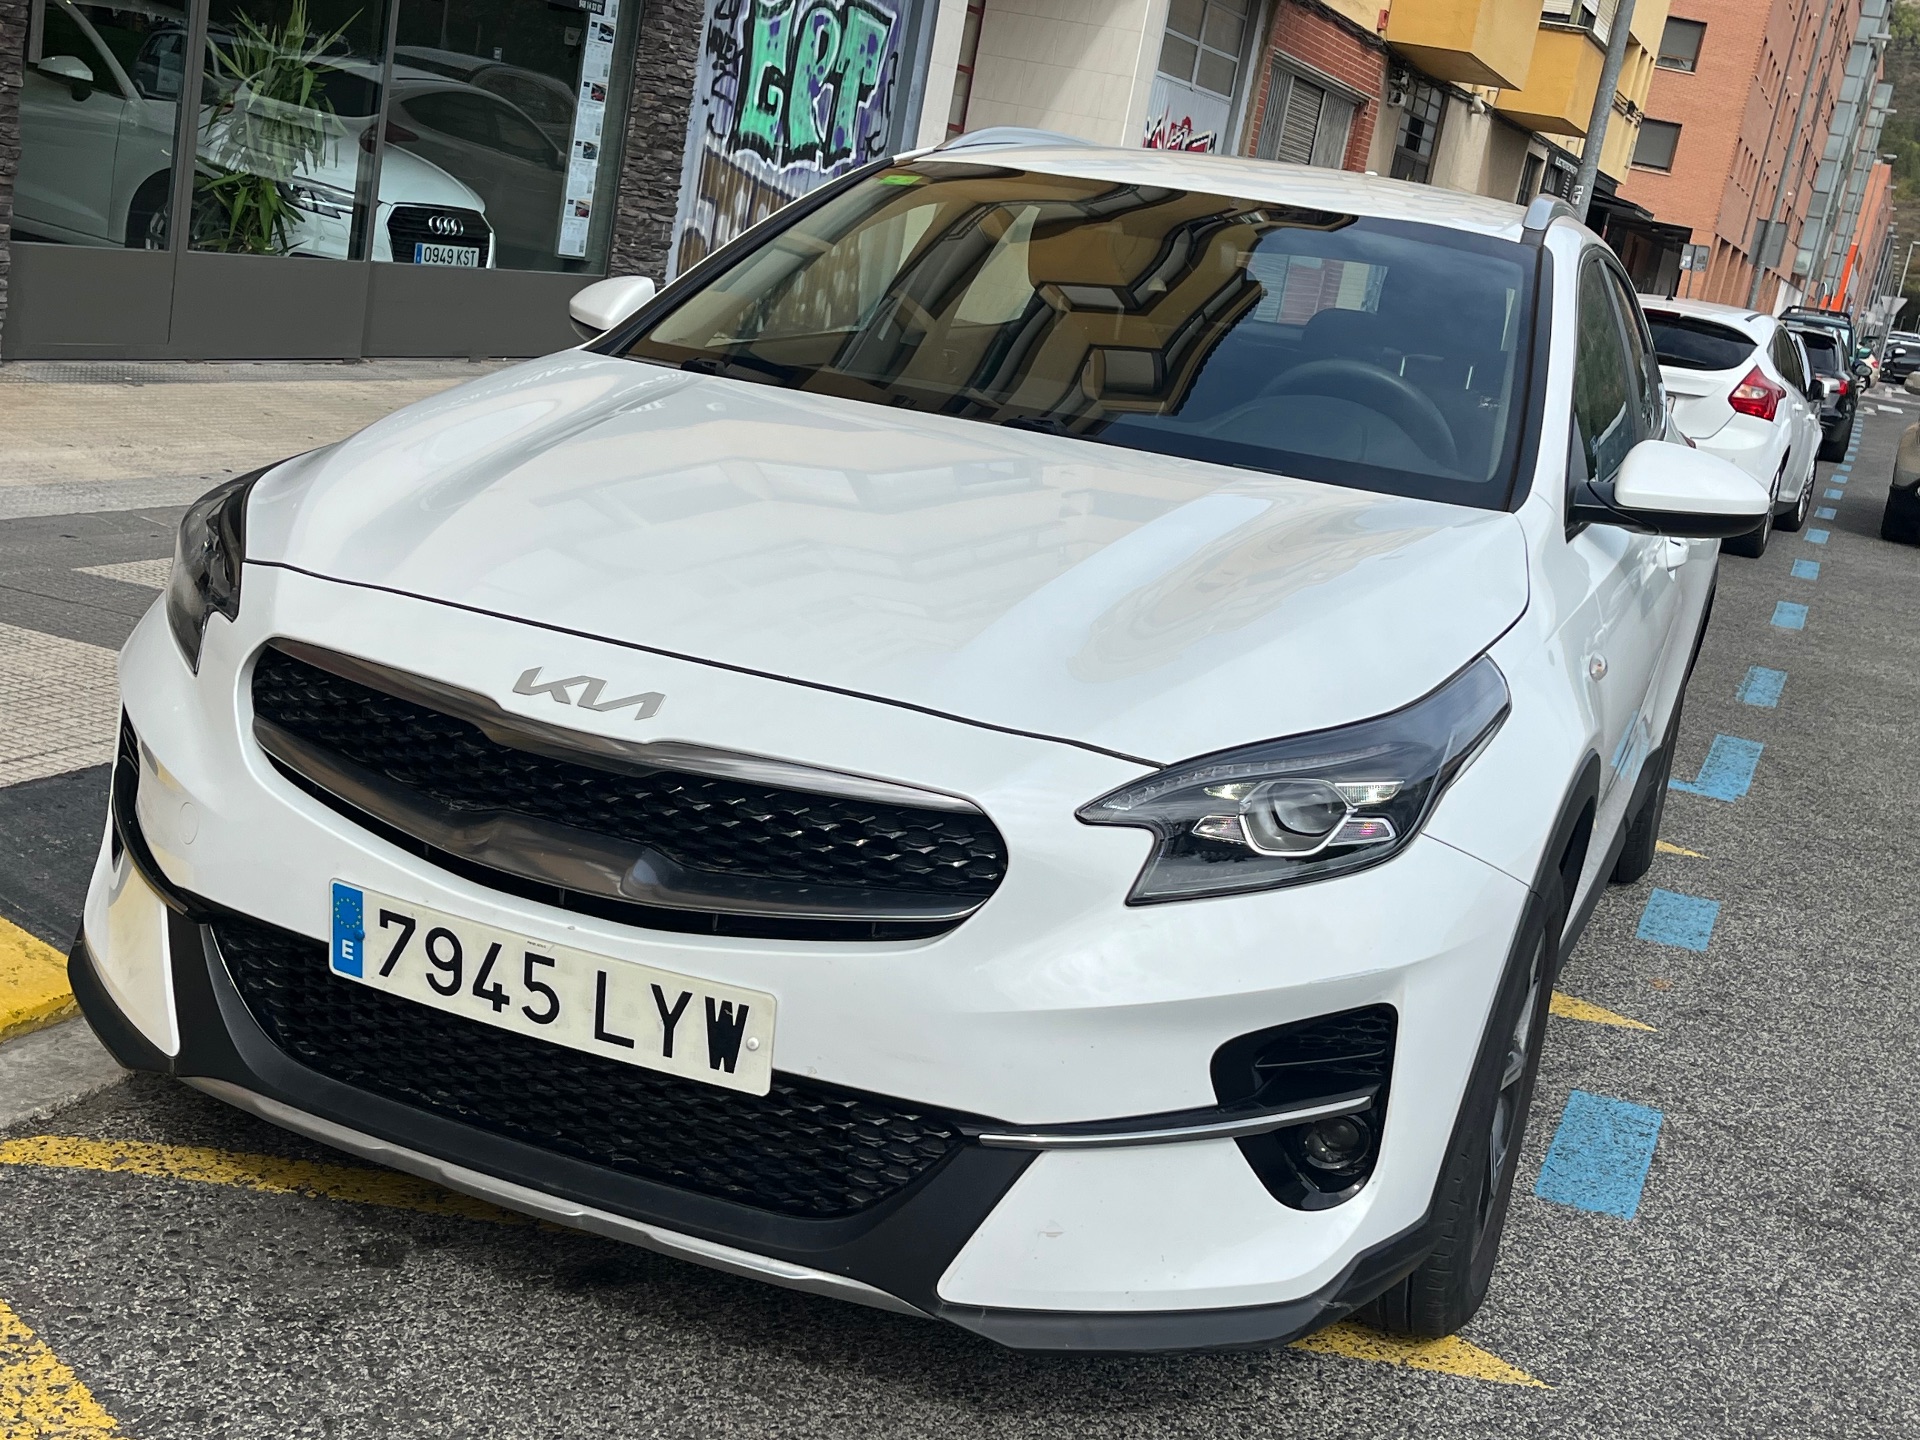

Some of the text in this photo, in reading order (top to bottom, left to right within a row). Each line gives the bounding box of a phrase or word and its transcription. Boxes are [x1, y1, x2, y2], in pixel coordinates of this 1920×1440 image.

[424, 246, 477, 267] 0949 KST
[341, 939, 354, 961] E
[378, 908, 750, 1075] 7945 LYW
